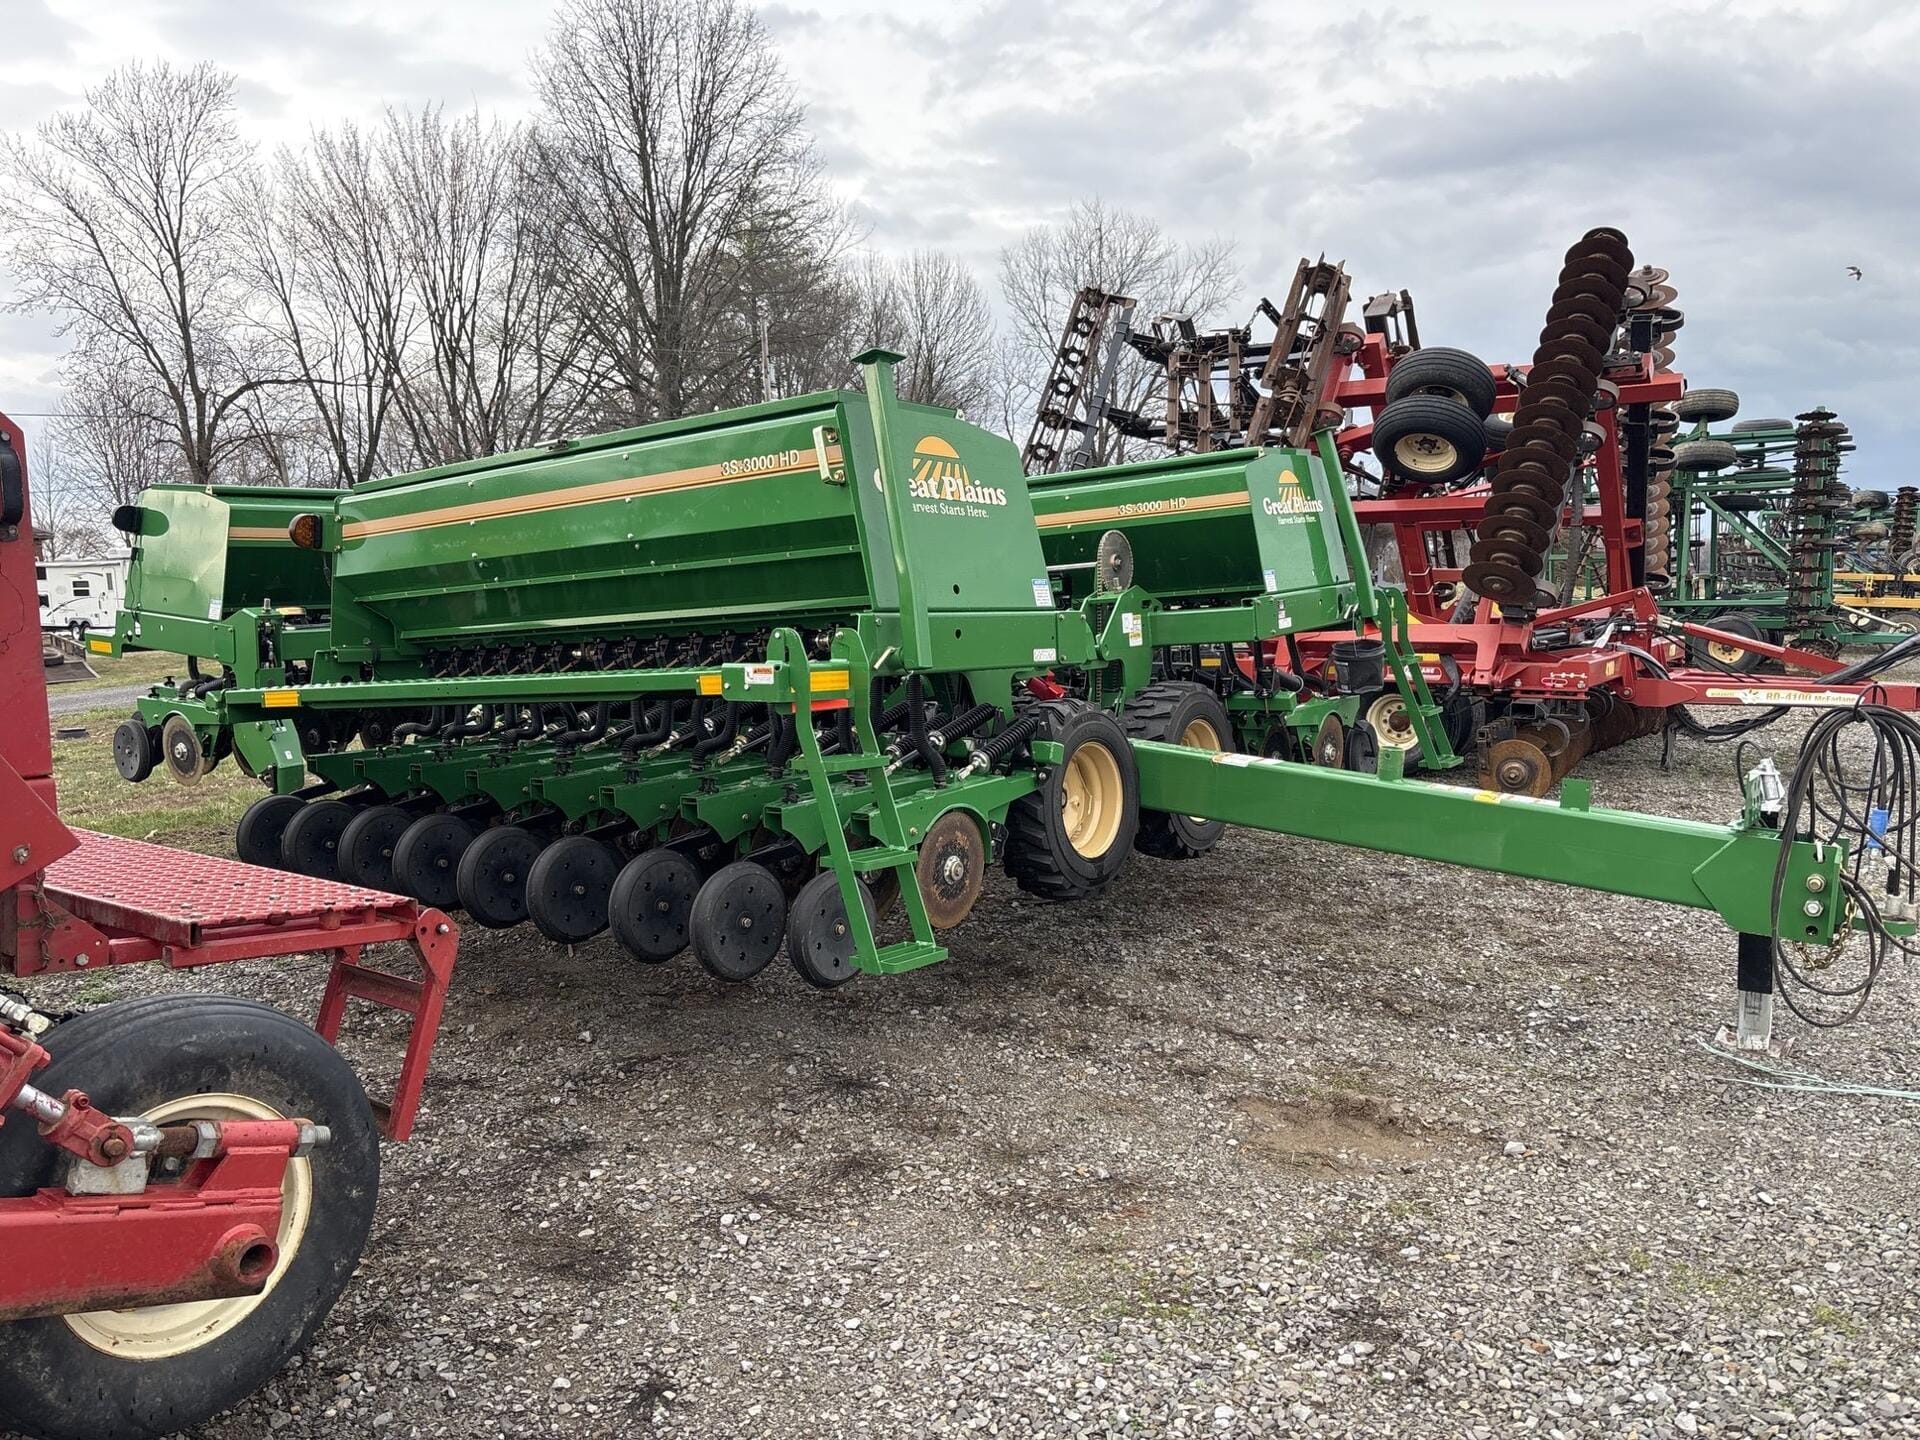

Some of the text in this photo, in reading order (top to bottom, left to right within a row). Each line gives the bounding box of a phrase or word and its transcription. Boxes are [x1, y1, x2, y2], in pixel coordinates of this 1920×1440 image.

[780, 450, 800, 468] HD
[941, 476, 1007, 506] Plains
[940, 502, 966, 517] Starts
[967, 505, 990, 519] Here.
[1169, 497, 1187, 509] HD
[1263, 496, 1324, 515] Great Plains
[1814, 694, 1856, 704] McFarlane
